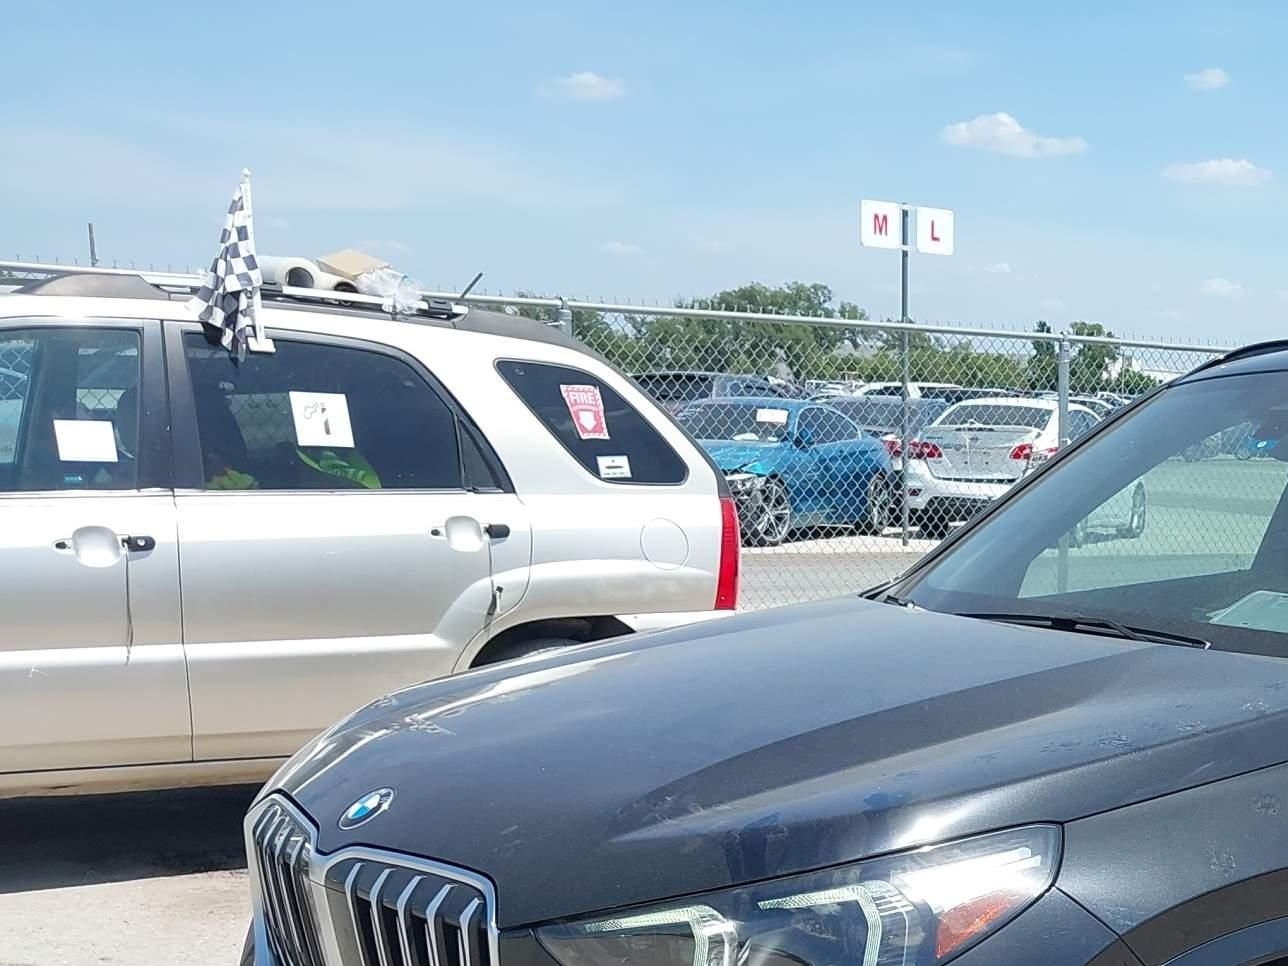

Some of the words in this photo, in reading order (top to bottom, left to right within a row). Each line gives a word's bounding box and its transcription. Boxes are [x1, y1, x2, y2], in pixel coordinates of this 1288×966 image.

[873, 213, 888, 236] M
[931, 219, 941, 242] L
[568, 391, 596, 405] FIRE
